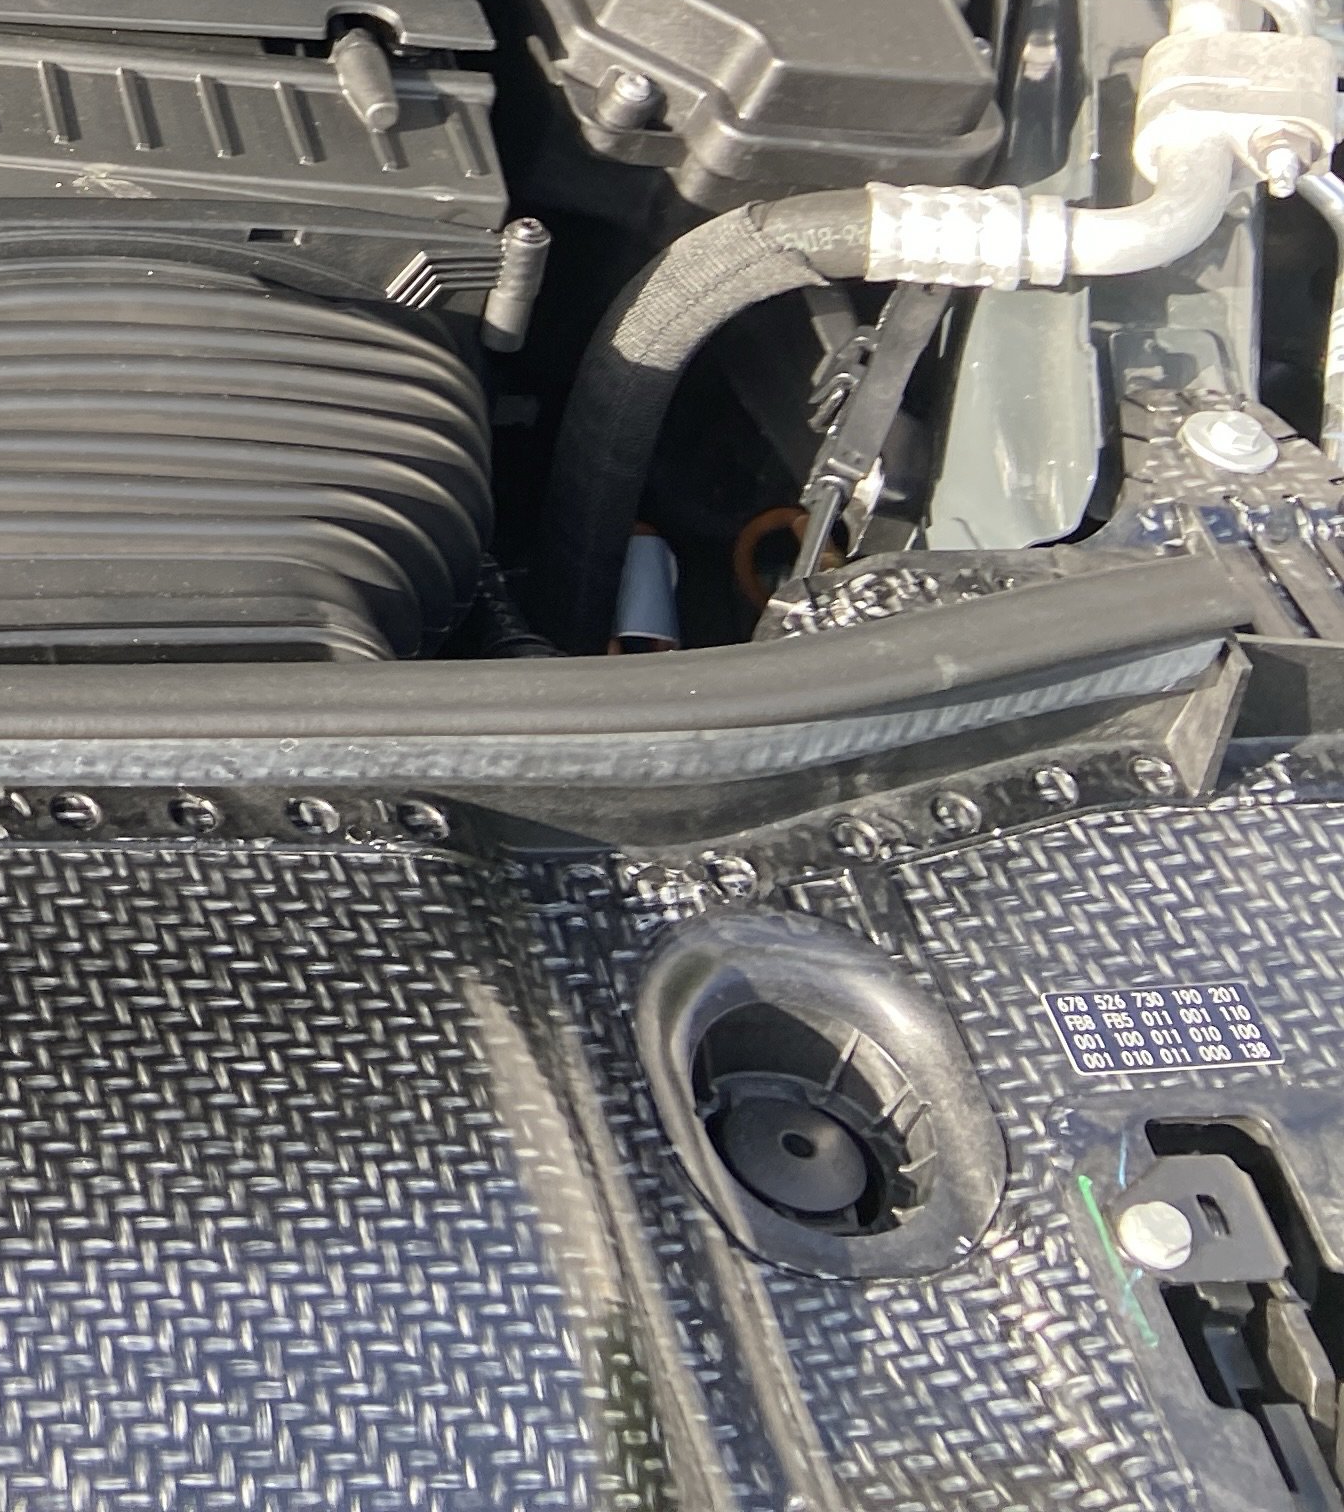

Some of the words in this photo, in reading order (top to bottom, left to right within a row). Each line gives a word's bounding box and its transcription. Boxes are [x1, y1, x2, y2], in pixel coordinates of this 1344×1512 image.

[1057, 996, 1088, 1012] 678
[1093, 994, 1126, 1010] 526
[1130, 991, 1165, 1007] 730
[1171, 988, 1203, 1005] 190
[1208, 986, 1240, 1003] 201
[1064, 1014, 1096, 1031] FB8
[1101, 1012, 1134, 1029] FB5
[1140, 1010, 1173, 1027] 011
[1179, 1007, 1212, 1024] 001
[1219, 1004, 1251, 1021] 110
[1073, 1033, 1105, 1050] 001
[1113, 1030, 1144, 1047] 100
[1150, 1028, 1183, 1045] 011
[1188, 1026, 1222, 1042] 010
[1229, 1023, 1261, 1040] 100
[1082, 1051, 1114, 1068] 001
[1121, 1049, 1153, 1066] 010
[1159, 1047, 1192, 1064] 011
[1198, 1044, 1232, 1061] 000
[1239, 1041, 1271, 1058] 138
